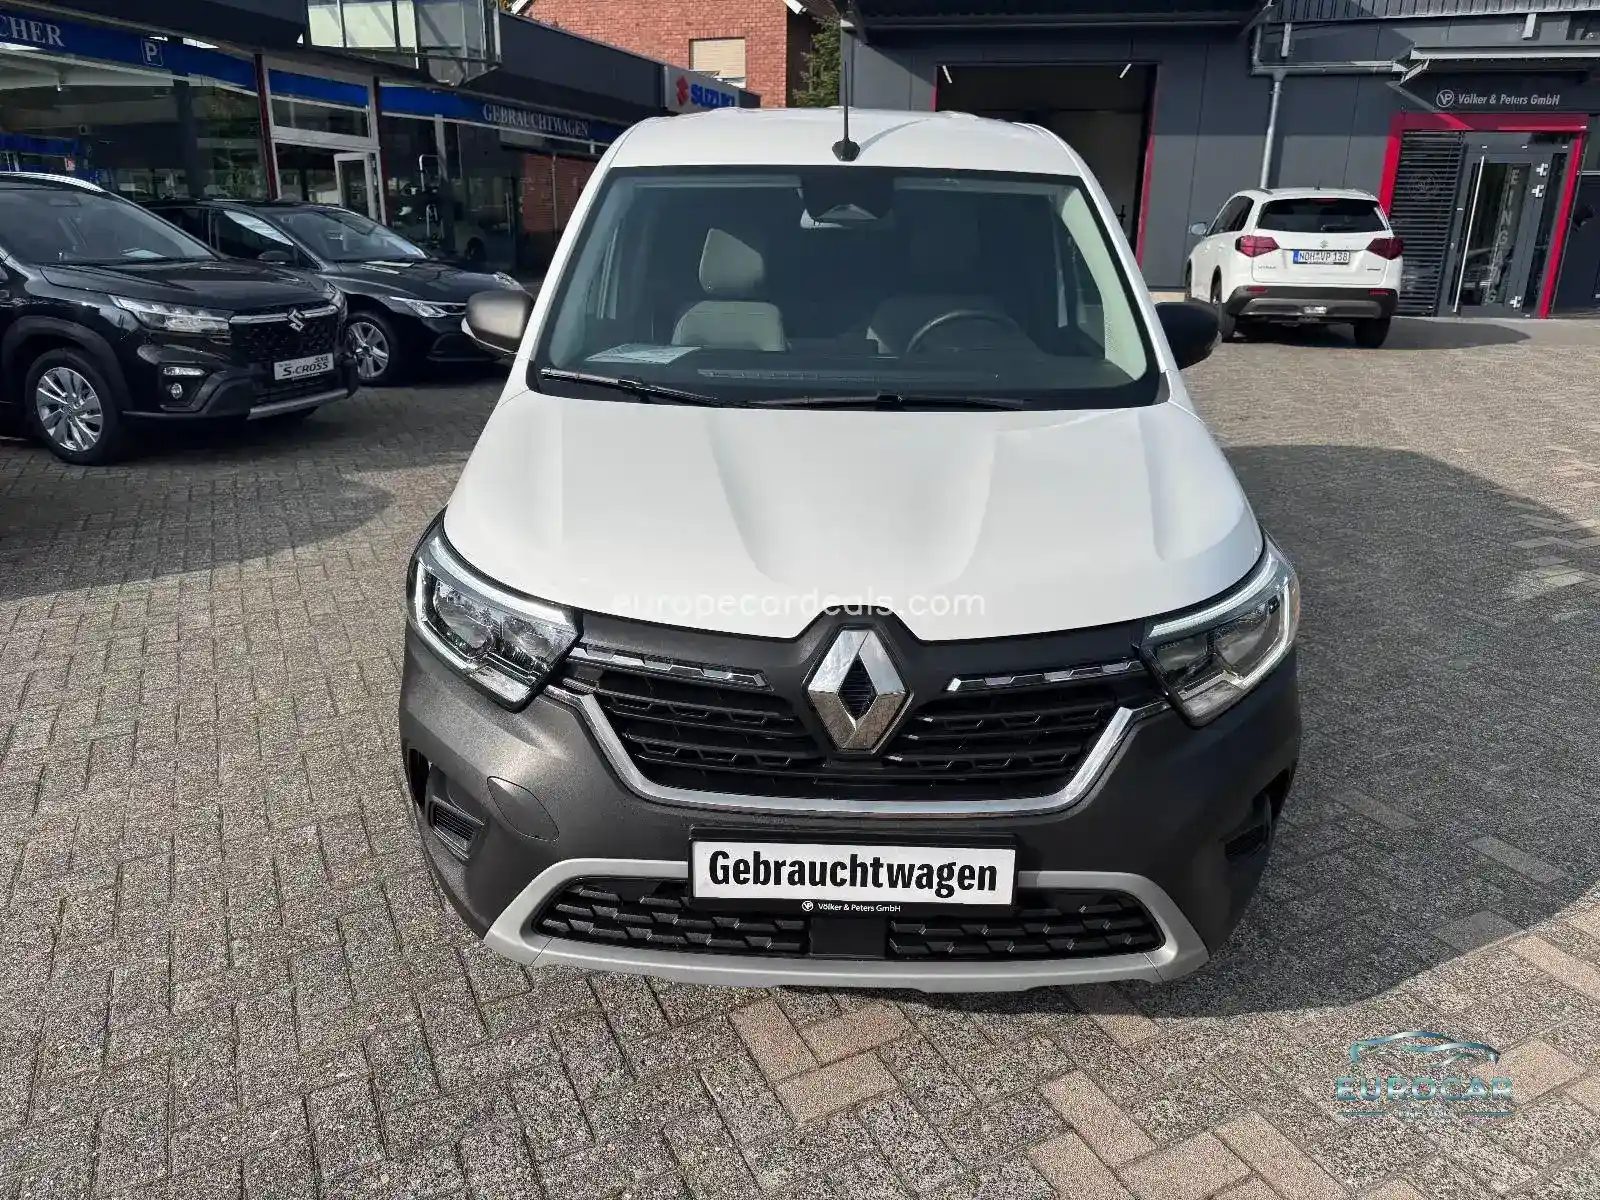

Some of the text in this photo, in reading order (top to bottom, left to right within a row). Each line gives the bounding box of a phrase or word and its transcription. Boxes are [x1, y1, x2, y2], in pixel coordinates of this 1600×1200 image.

[144, 42, 157, 62] P
[1458, 93, 1487, 105] Völker
[1490, 94, 1497, 104] &
[1500, 94, 1528, 105] Peters
[1530, 94, 1560, 106] GmbH
[482, 103, 589, 136] GEBRAUCHTWAGEN
[1333, 253, 1348, 262] 138
[709, 850, 998, 899] Gebrauchtwagen
[818, 902, 842, 911] Völker
[851, 904, 875, 912] Peters
[876, 904, 901, 912] GmbH
